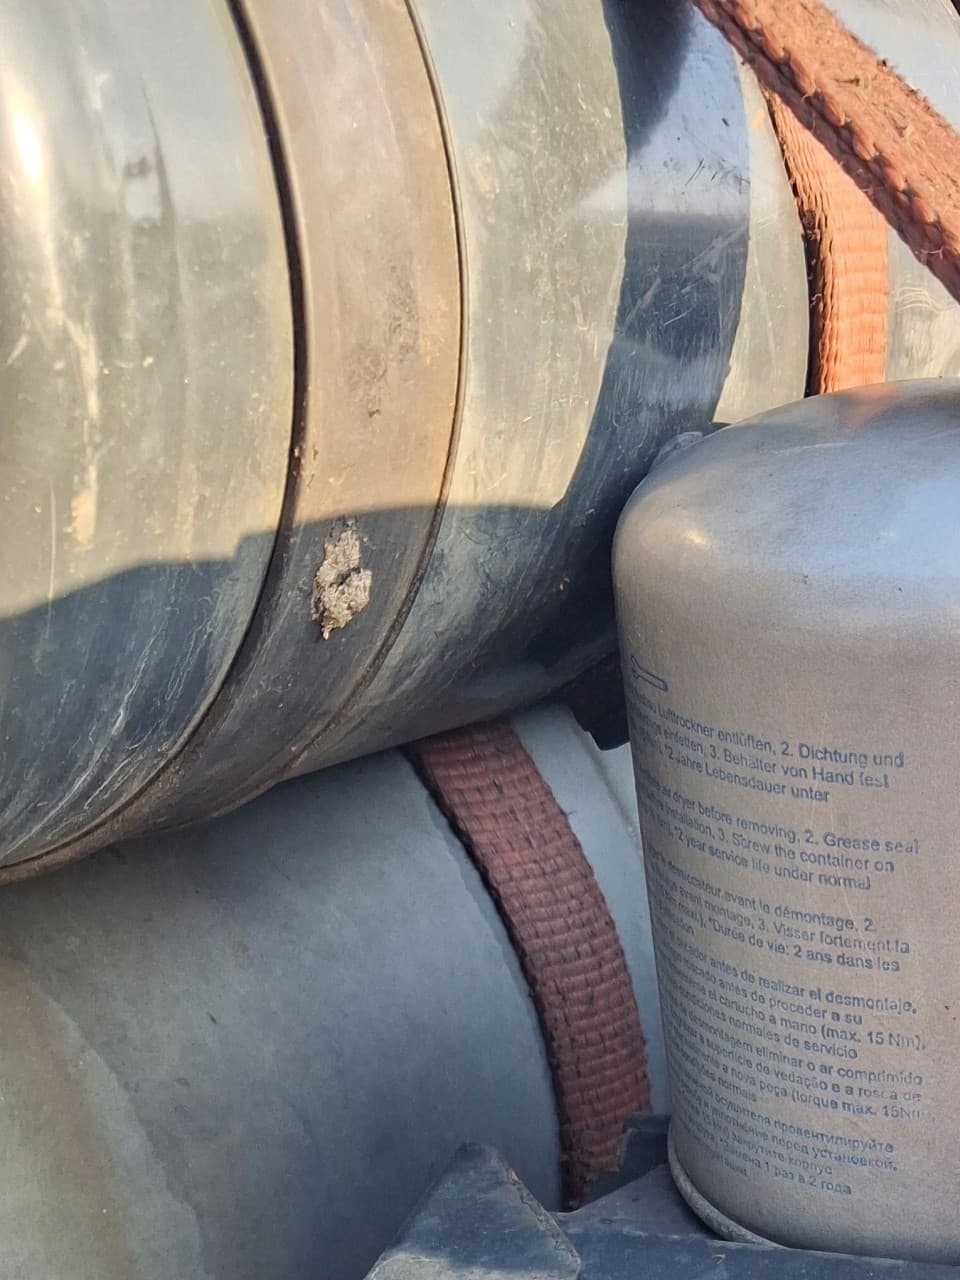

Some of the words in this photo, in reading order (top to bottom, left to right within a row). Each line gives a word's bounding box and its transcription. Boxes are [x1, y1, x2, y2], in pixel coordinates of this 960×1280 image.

[799, 743, 867, 769] Dichtung
[873, 752, 905, 767] und
[706, 764, 786, 795] Lebensdauer
[792, 787, 830, 802] unter
[781, 766, 808, 780] von
[813, 766, 854, 786] Hand
[859, 773, 889, 788] fest
[698, 798, 732, 824] before
[736, 816, 800, 843] removing,
[805, 829, 819, 844] 2.
[823, 832, 880, 851] Grease
[884, 839, 919, 854] seal
[708, 842, 748, 867] service
[752, 858, 770, 873] life
[774, 865, 813, 883] under
[819, 873, 870, 890] normal
[732, 831, 770, 853] Screw
[775, 843, 796, 860] the
[800, 847, 869, 872] container
[874, 860, 895, 872] on
[749, 934, 763, 948] de
[793, 945, 802, 958] 2
[807, 951, 833, 964] ans
[836, 954, 872, 970] dans
[877, 958, 900, 971] les
[774, 922, 815, 942] Visser
[819, 930, 893, 953] fortement
[741, 968, 755, 983] de
[759, 976, 804, 997] realizar
[809, 988, 821, 1001] el
[751, 991, 765, 1004] de
[769, 998, 826, 1020] proceder
[831, 1011, 841, 1021] a
[845, 1013, 863, 1025] su
[729, 1017, 780, 1043] normales
[784, 1032, 799, 1047] de
[804, 1039, 857, 1059] servicio
[769, 1014, 777, 1024] a
[780, 1019, 817, 1035] mano
[821, 1023, 860, 1043] (max.
[867, 1031, 884, 1044] 15
[756, 1047, 802, 1069] eliminar
[807, 1062, 816, 1071] o
[819, 1064, 833, 1074] ar
[837, 1067, 922, 1085] comprimido
[756, 1060, 770, 1073] de
[832, 1083, 841, 1093] e
[845, 1086, 854, 1095] a
[858, 1087, 898, 1101] rosca
[842, 1101, 876, 1115] max.
[809, 1176, 816, 1186] 2
[821, 1180, 852, 1195] года
